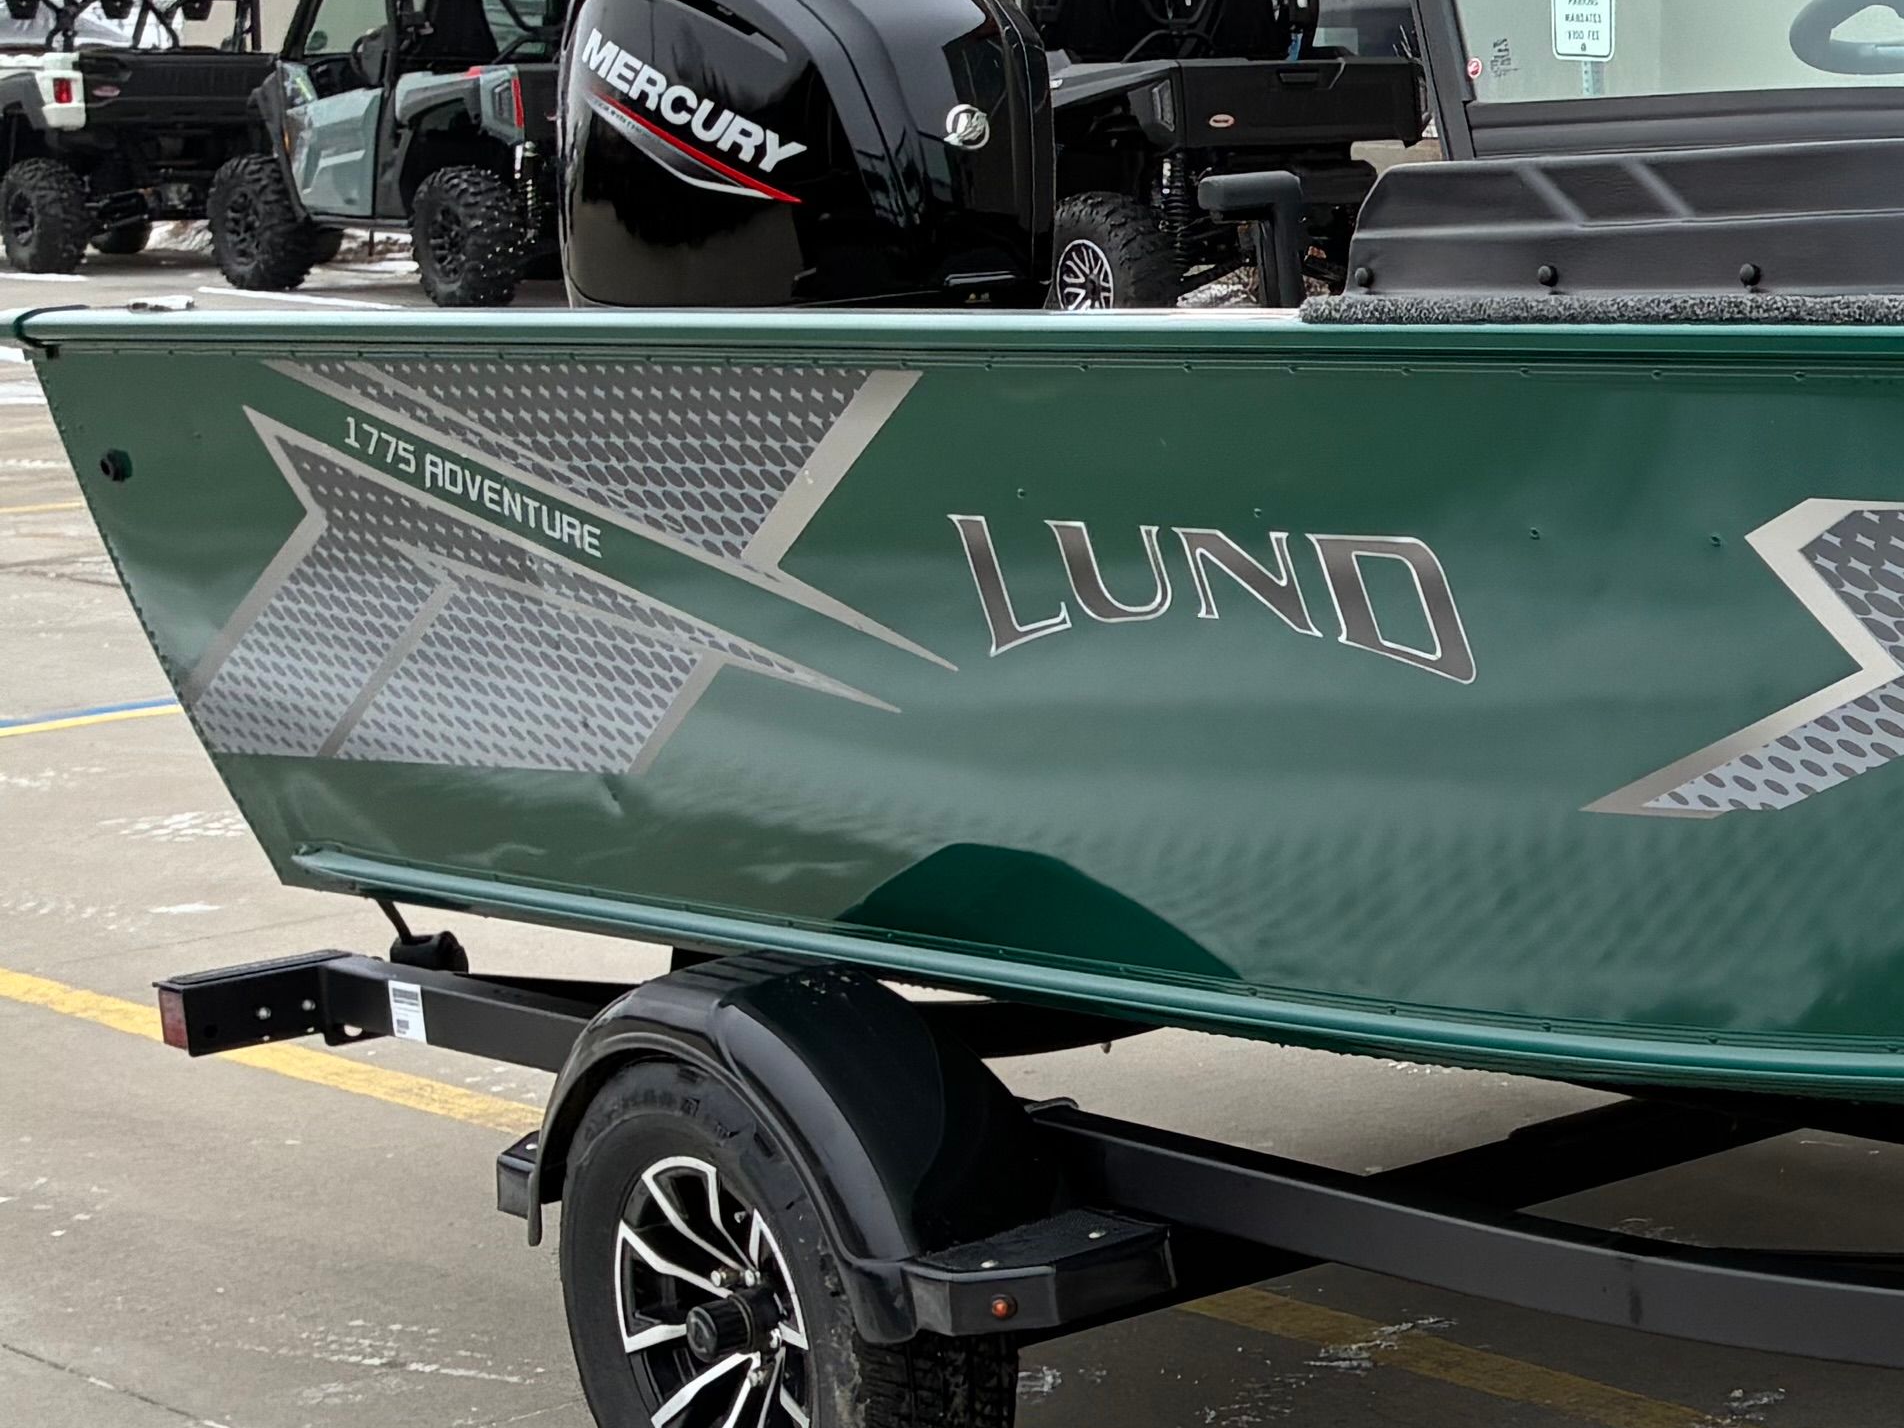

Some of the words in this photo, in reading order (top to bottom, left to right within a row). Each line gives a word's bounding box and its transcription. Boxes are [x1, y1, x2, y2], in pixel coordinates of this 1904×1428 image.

[582, 28, 807, 173] MERCURY
[344, 415, 416, 474] 1775
[424, 452, 603, 559] ADVENTURE
[947, 513, 1477, 685] LUND
